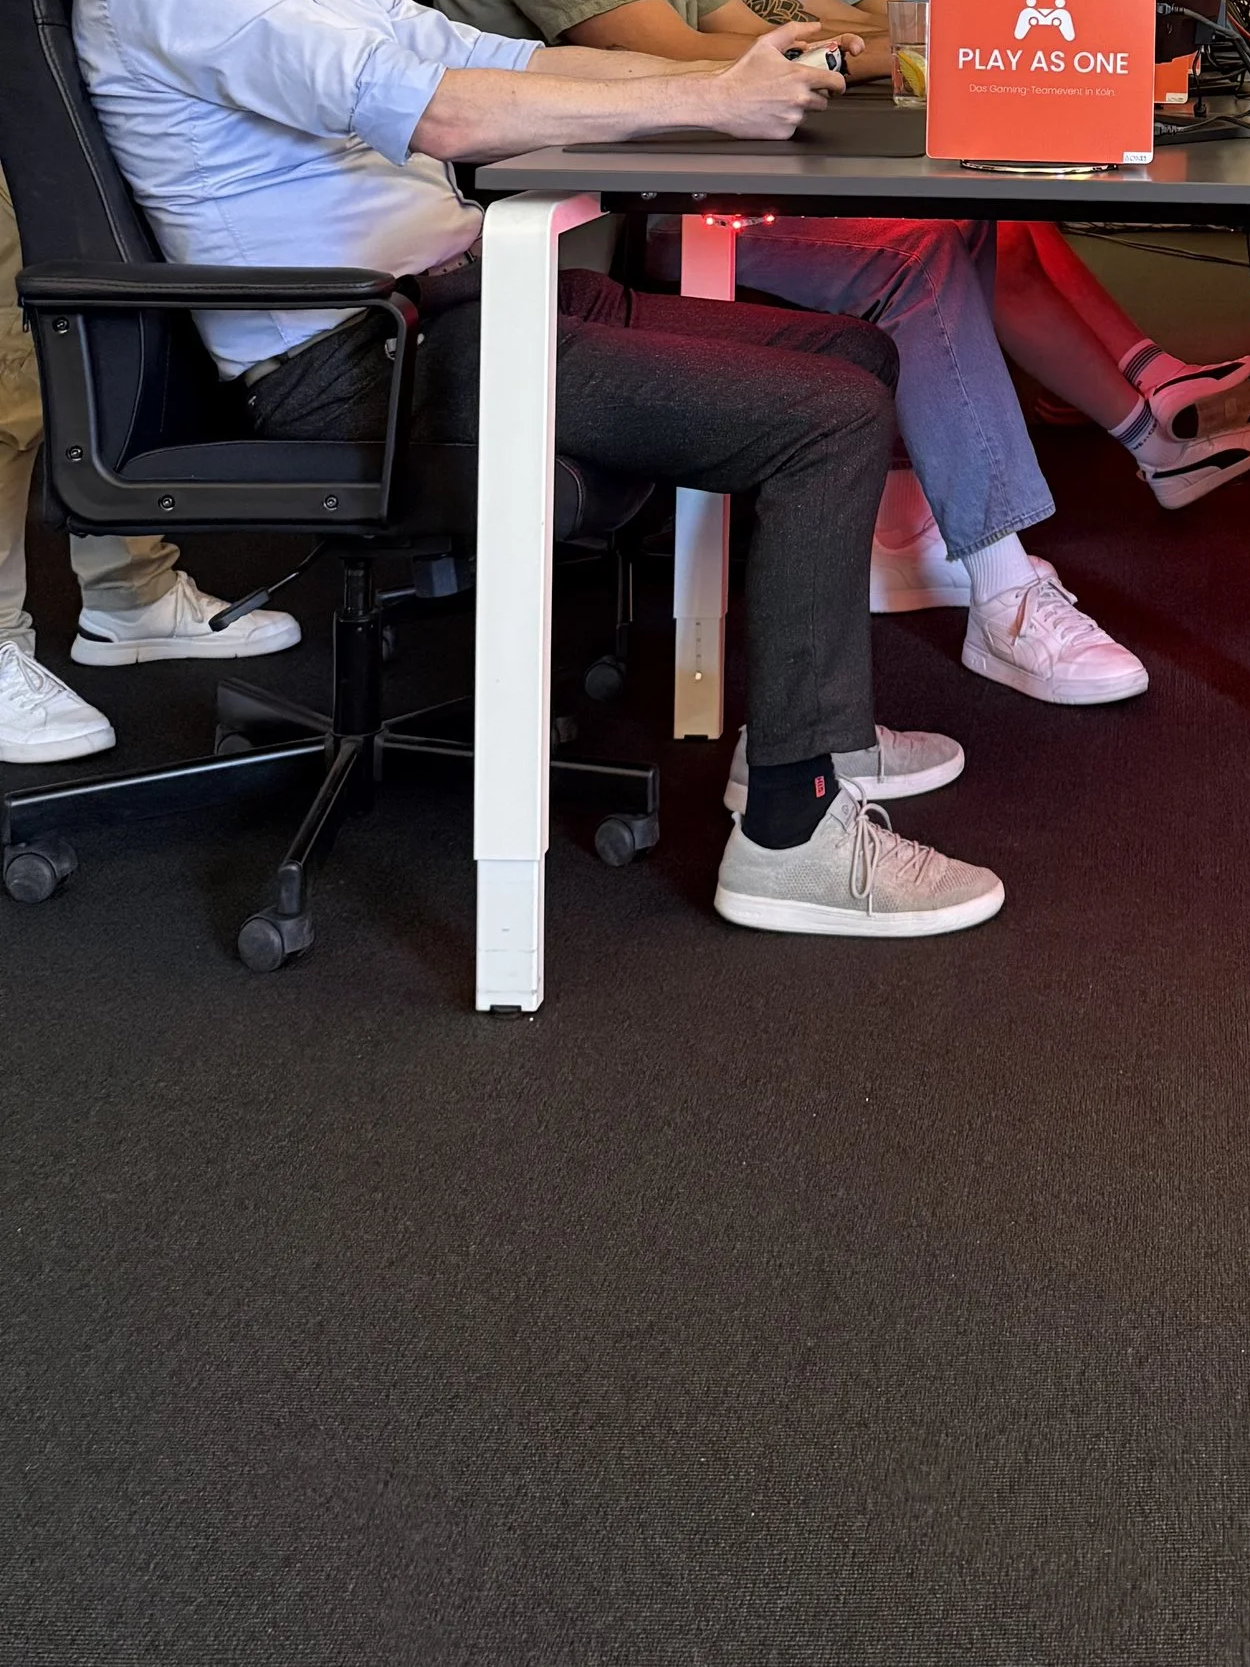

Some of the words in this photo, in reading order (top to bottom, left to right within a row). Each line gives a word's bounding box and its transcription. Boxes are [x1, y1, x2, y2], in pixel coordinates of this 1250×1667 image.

[958, 48, 1023, 71] PLAY
[1030, 50, 1065, 72] AS
[1073, 51, 1129, 74] ONE
[969, 84, 987, 93] Das
[989, 84, 1083, 97] Gaming-Teamevent
[1085, 87, 1093, 96] in
